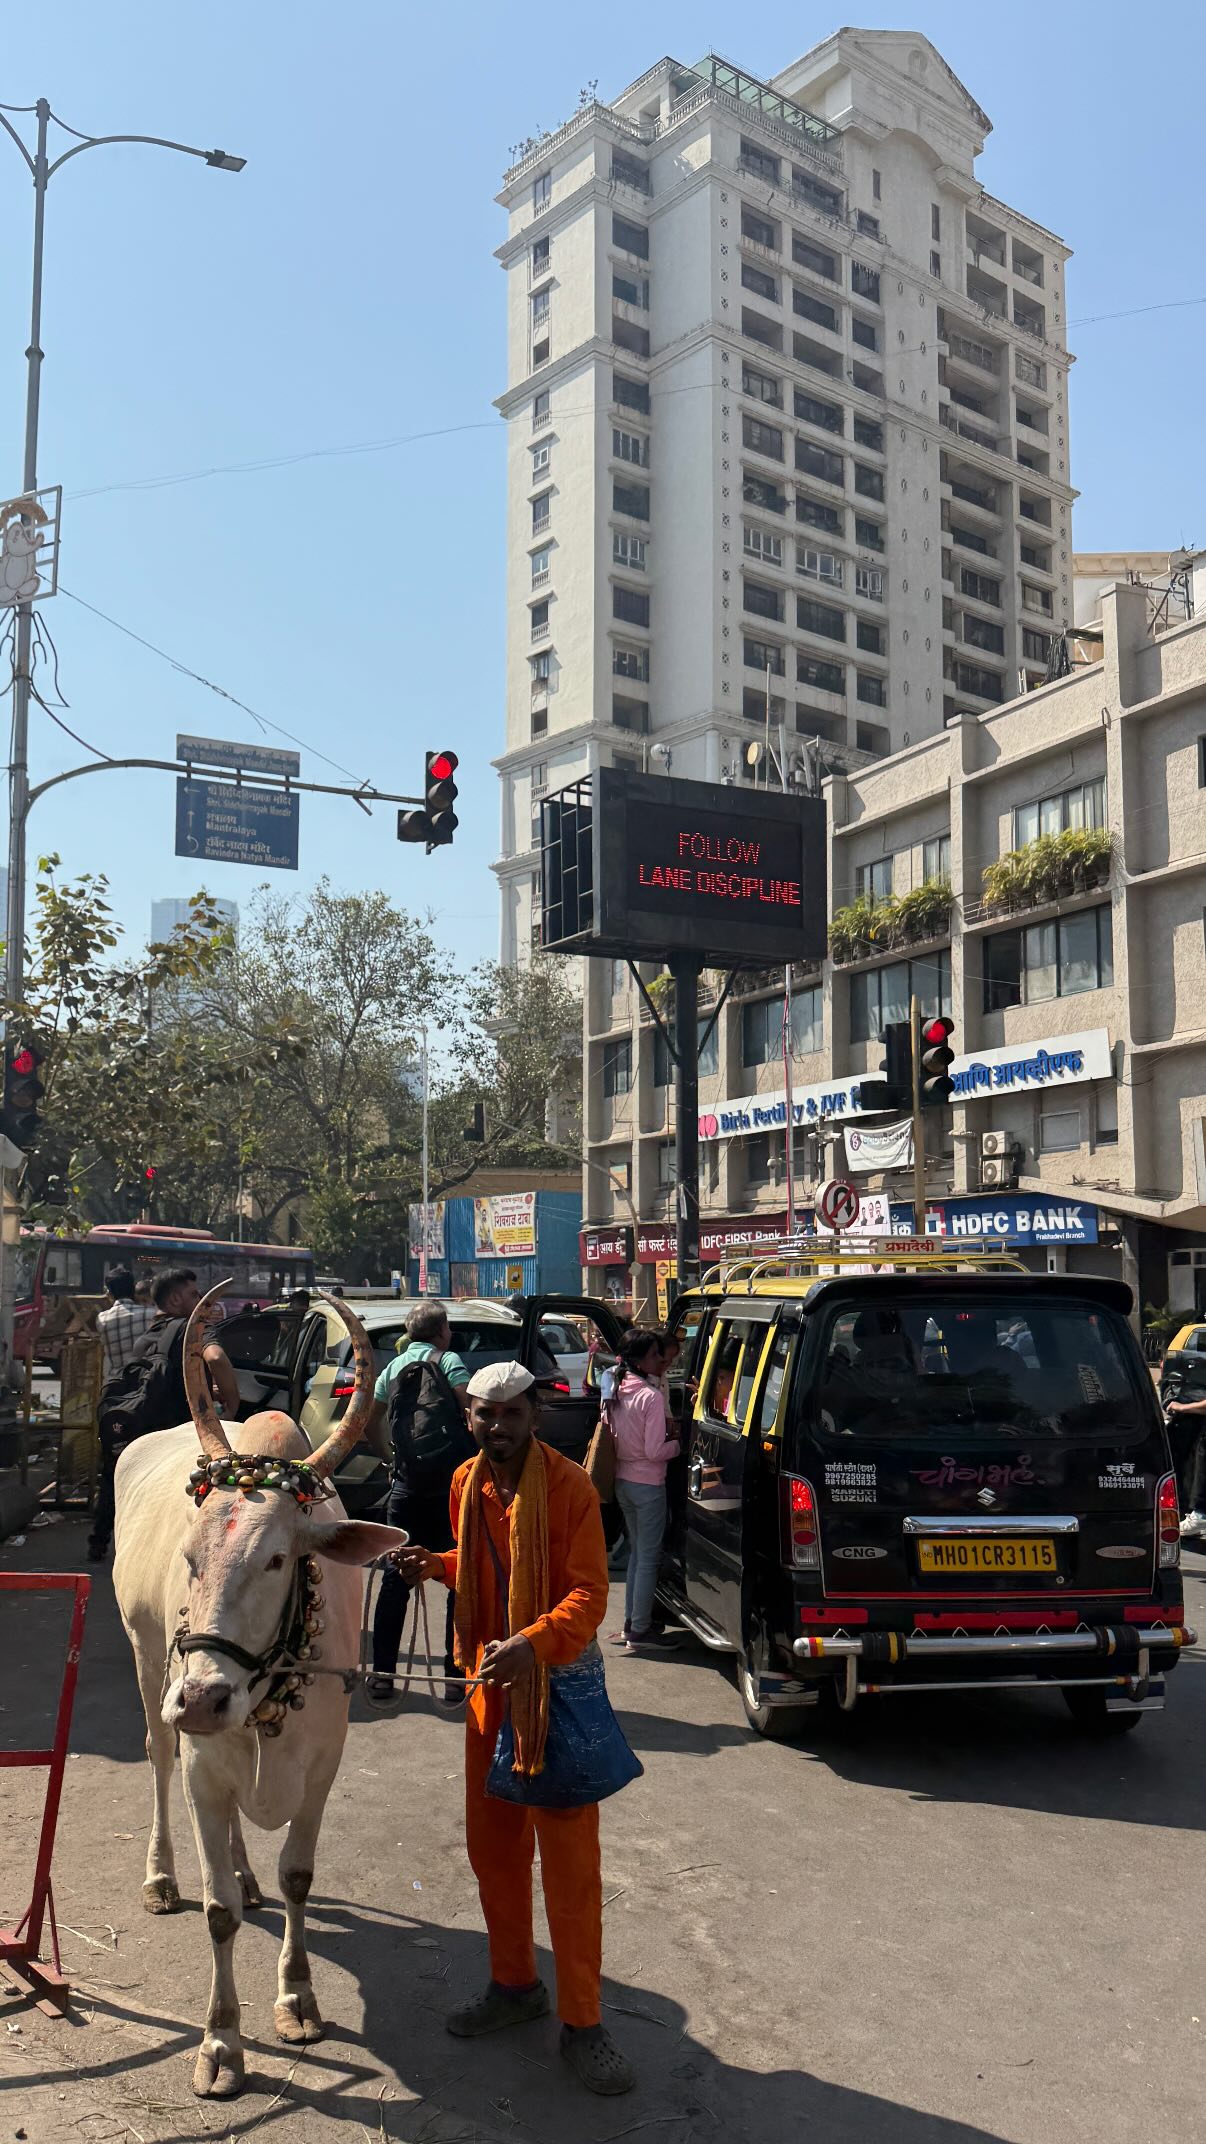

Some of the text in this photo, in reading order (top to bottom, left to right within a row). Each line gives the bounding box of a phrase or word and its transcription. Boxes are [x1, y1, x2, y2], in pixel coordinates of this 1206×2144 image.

[206, 821, 257, 837] Mantralaya
[205, 847, 291, 865] Ravindra Natya Mandir
[679, 832, 761, 865] FOLLOW
[639, 864, 801, 905] LANE DISCIPLINE
[992, 1049, 1084, 1087] आयव्हीएफ
[719, 1109, 751, 1131] Birla
[752, 1101, 805, 1128] Fertily
[806, 1097, 819, 1117] &
[820, 1092, 848, 1115] IVF
[952, 1206, 1084, 1235] HDFC BANK
[701, 1235, 723, 1250] IDFC
[725, 1231, 753, 1245] FIRST
[884, 1239, 936, 1252] प्रभादेवी
[1036, 1231, 1085, 1241] Prabhadevi Branch
[831, 1495, 877, 1503] SUZUKI
[842, 1548, 876, 1559] CNG
[933, 1544, 1053, 1566] MH01CR3115
